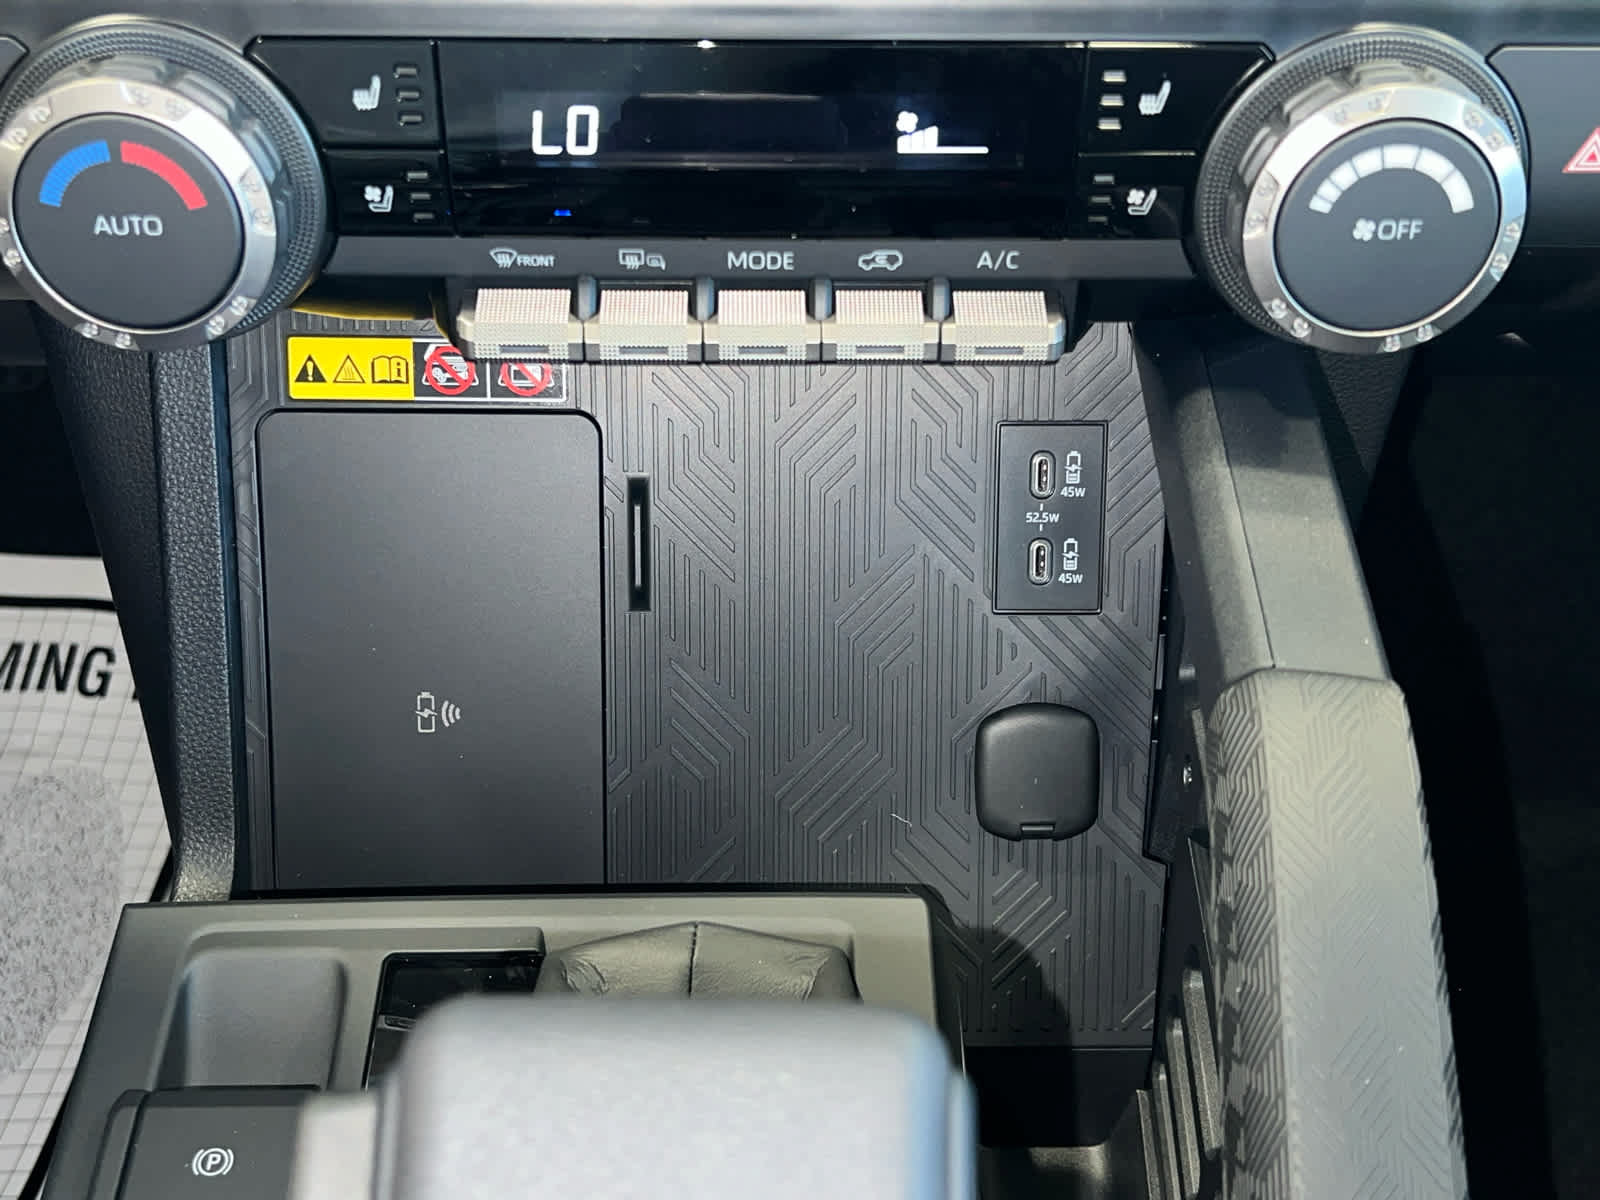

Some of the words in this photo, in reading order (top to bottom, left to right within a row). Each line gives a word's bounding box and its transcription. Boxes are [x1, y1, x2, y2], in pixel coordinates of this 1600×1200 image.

[531, 104, 600, 156] LO
[93, 214, 164, 237] AUTO
[1377, 219, 1423, 241] OFF
[516, 253, 555, 268] FRONT
[726, 251, 795, 270] MODE
[976, 250, 1020, 270] A/C
[1060, 486, 1086, 498] 45W
[1025, 512, 1060, 524] 52.5W
[1058, 573, 1084, 584] 45W
